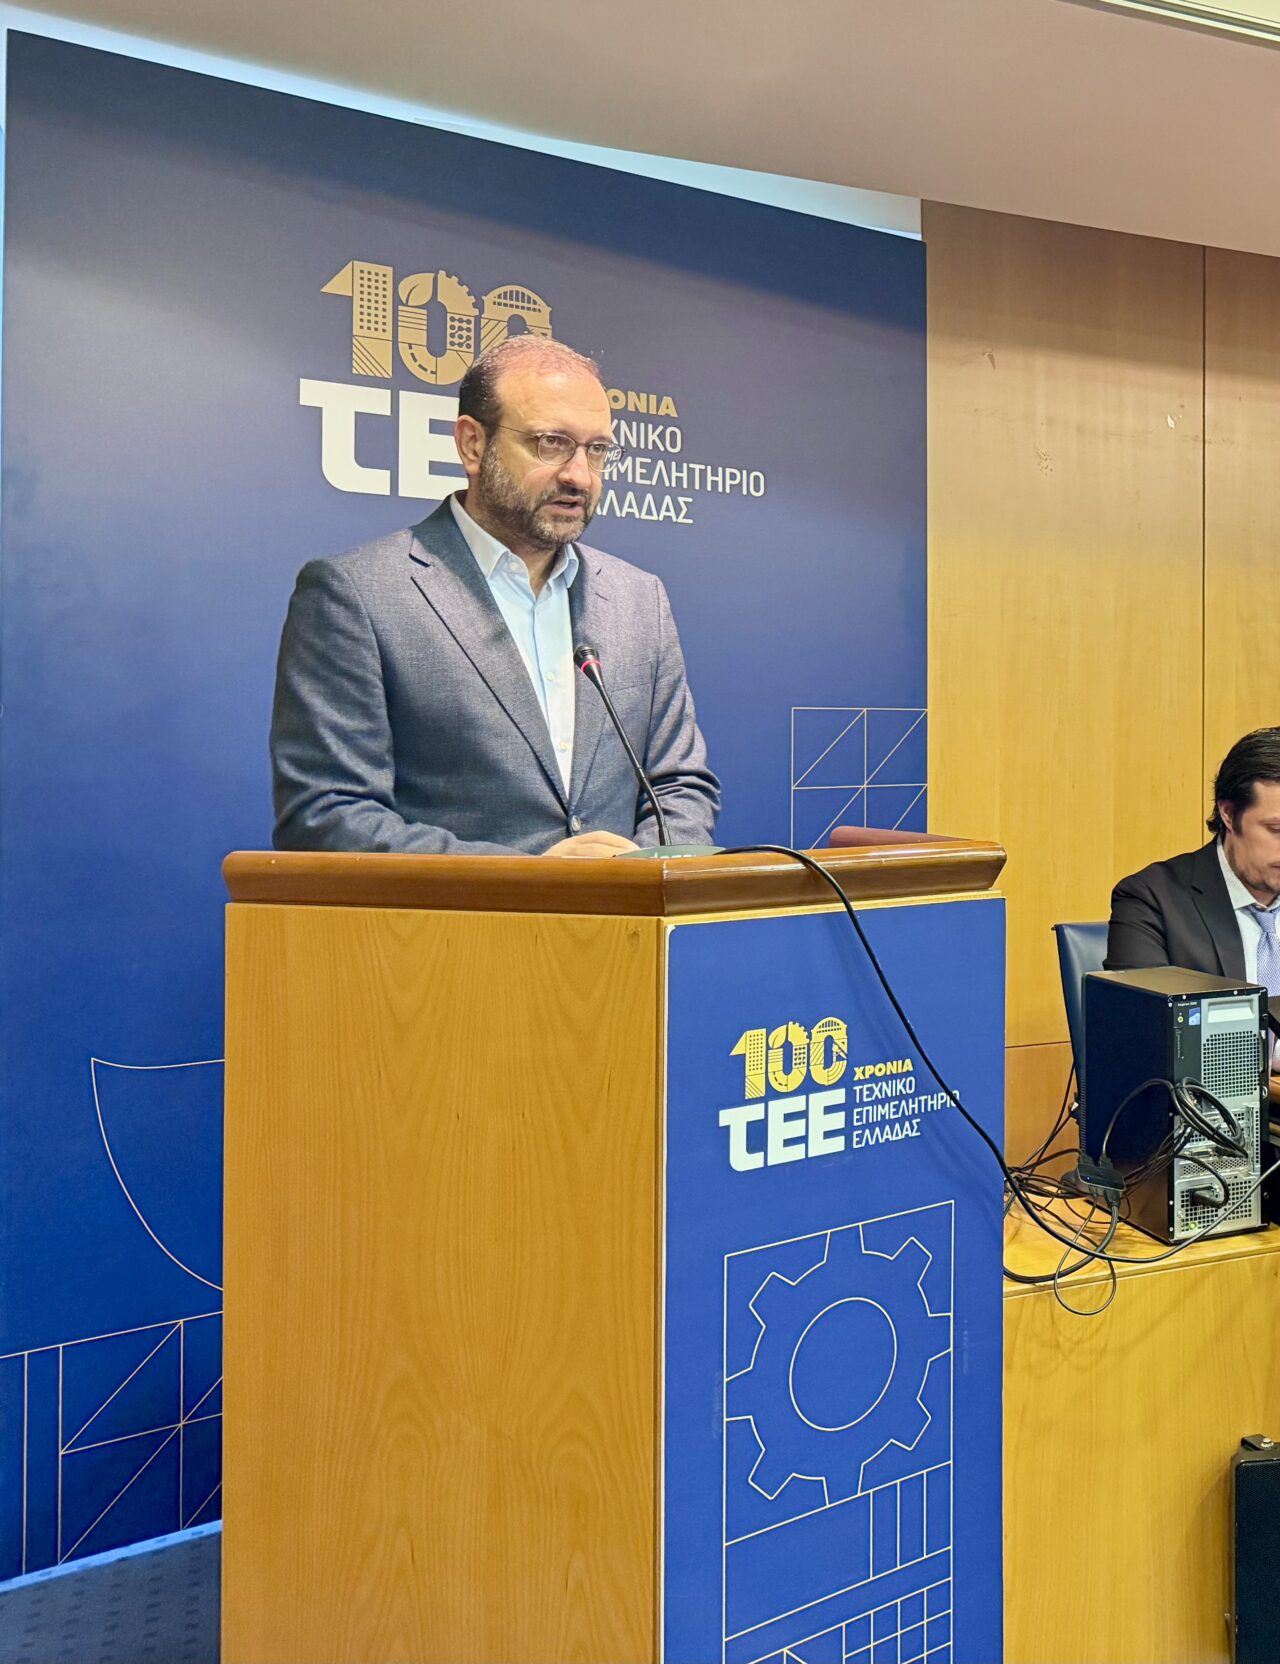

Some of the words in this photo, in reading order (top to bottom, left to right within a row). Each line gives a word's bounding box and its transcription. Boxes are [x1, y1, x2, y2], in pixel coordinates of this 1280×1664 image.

[729, 1016, 849, 1100] 100
[853, 1058, 914, 1082] ΧΡΟΝΙΑ
[853, 1075, 916, 1104] ΤΕΧΝΙΚΟ
[853, 1089, 961, 1127] ΕΠΙΜΕΛΗΤΗΡΙΟ
[718, 1087, 846, 1172] ΤΕΕ
[852, 1118, 921, 1149] ΕΛΛΑΔΑΣ
